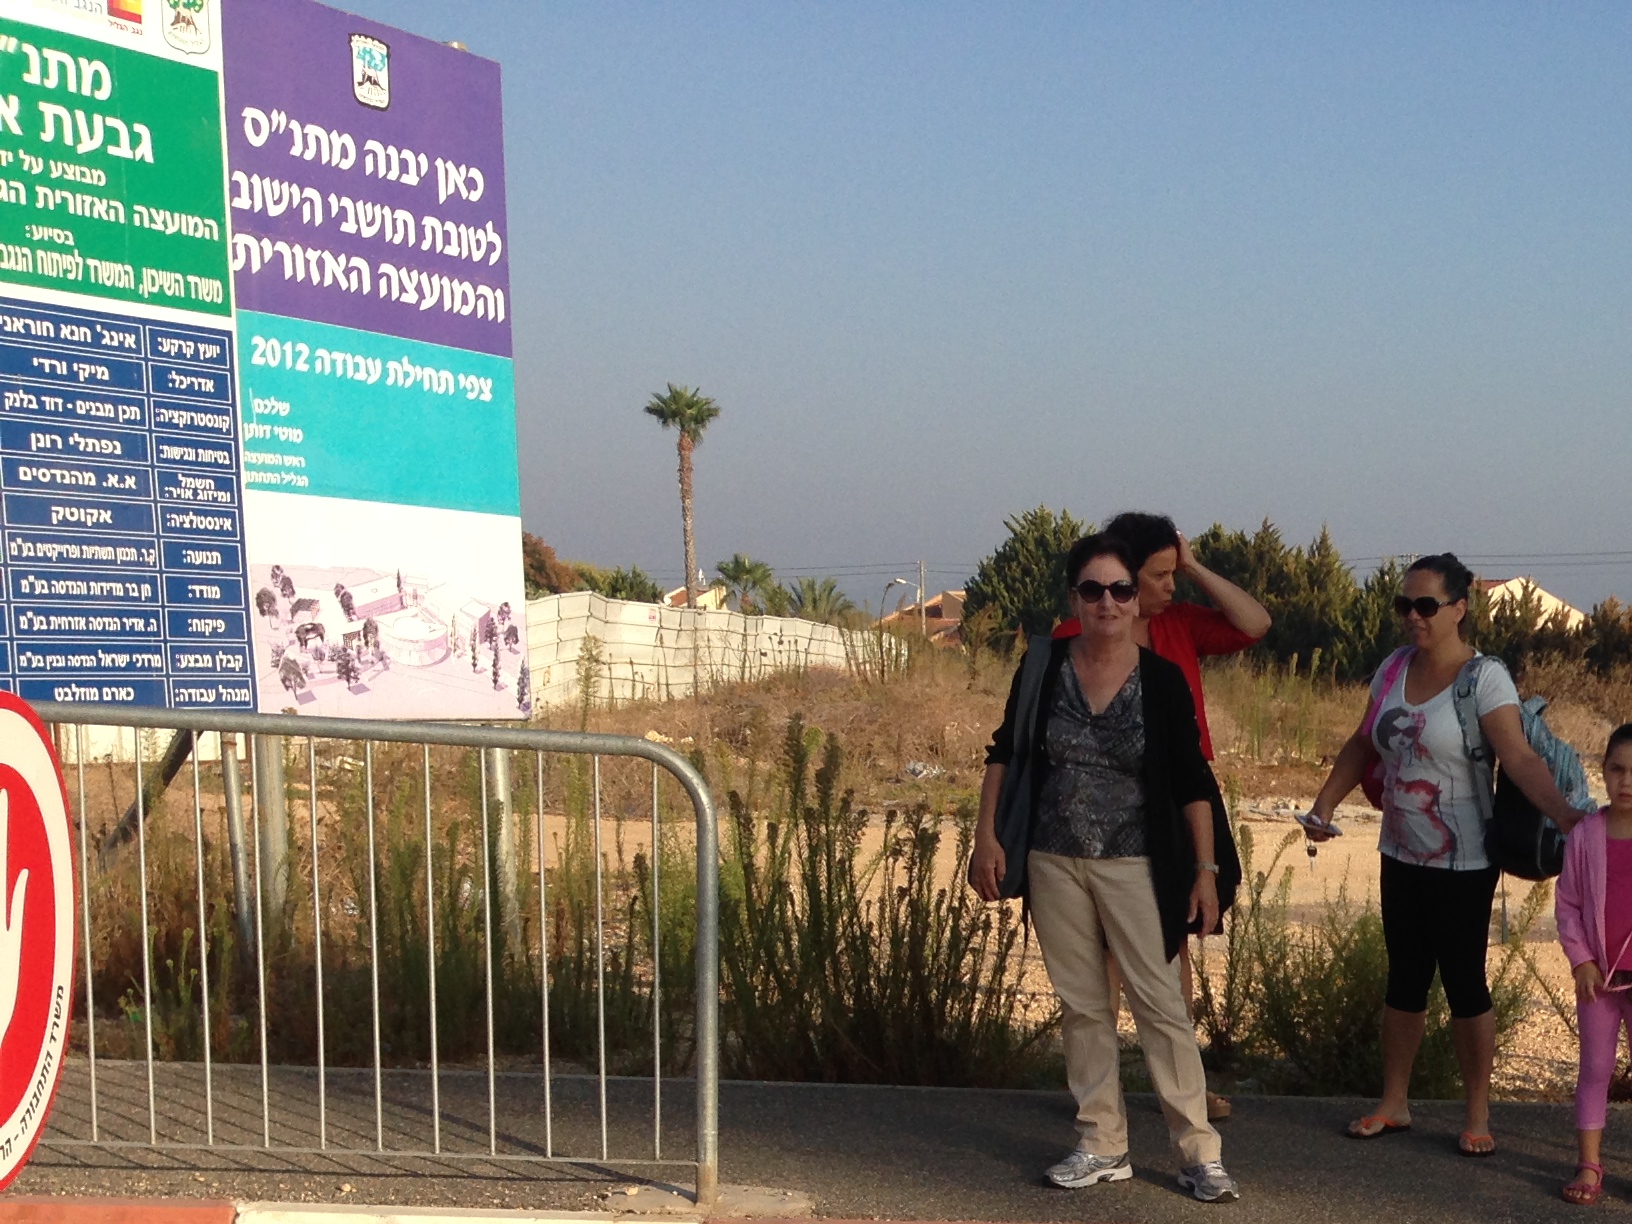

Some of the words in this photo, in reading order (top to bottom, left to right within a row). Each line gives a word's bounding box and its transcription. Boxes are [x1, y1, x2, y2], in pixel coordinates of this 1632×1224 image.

[38, 100, 154, 164] גבעת
[241, 106, 357, 170] מתנ"ס
[18, 148, 44, 175] על
[363, 139, 428, 186] יבנה
[50, 159, 107, 187] מבוצע
[434, 157, 484, 205] כאן
[35, 185, 125, 224] האזורית
[231, 170, 323, 227] הישוב
[133, 204, 219, 241] המועצה
[328, 192, 416, 248] תושבי
[25, 224, 75, 246] בסיוע:
[421, 215, 502, 266] לטובת
[37, 249, 83, 281] לפיתוח
[85, 257, 135, 290] המשרד
[232, 233, 371, 295] האזורית
[139, 267, 185, 299] השיכון,
[187, 273, 223, 304] משרד
[378, 263, 506, 323] והמועצה
[60, 323, 92, 343] חנא
[96, 324, 137, 349] אינג'
[157, 336, 195, 359] קרקע:
[197, 342, 220, 360] יועץ
[250, 335, 310, 372] 2012
[32, 357, 68, 375] ורדי
[73, 362, 110, 381] מיקי
[314, 348, 383, 385] עבודה
[386, 355, 455, 396] תחילת
[167, 370, 215, 393] אדריכל:
[457, 372, 493, 402] צפי
[4, 389, 39, 411] בלנק
[41, 396, 64, 412] דוד
[76, 400, 115, 418] מבנים
[253, 395, 291, 417] שלכם
[118, 404, 141, 422] תכן
[30, 432, 63, 452] רונן
[68, 432, 122, 454] נפתלי
[243, 422, 272, 442] דותן
[273, 425, 304, 444] מוטי
[18, 466, 97, 486] מהנדסים
[177, 473, 215, 490] חשמל
[197, 489, 231, 503] ומיזוג
[51, 505, 113, 527] אקוטק
[51, 580, 87, 596] והנדסה
[187, 584, 221, 599] מודד:
[49, 615, 87, 630] אזרחית
[88, 616, 121, 631] הנדסה
[122, 617, 146, 632] אדיר
[187, 618, 225, 636] פיקוח:
[67, 654, 97, 667] הנדסה
[97, 648, 130, 668] ישראל
[132, 653, 162, 668] מרדכי
[215, 650, 243, 672] קבלן
[102, 686, 135, 701] כארם
[175, 688, 216, 703] עבודה:
[218, 684, 250, 702] מנהל
[49, 984, 64, 1044] משרד
[20, 1049, 53, 1136] התחבורה
